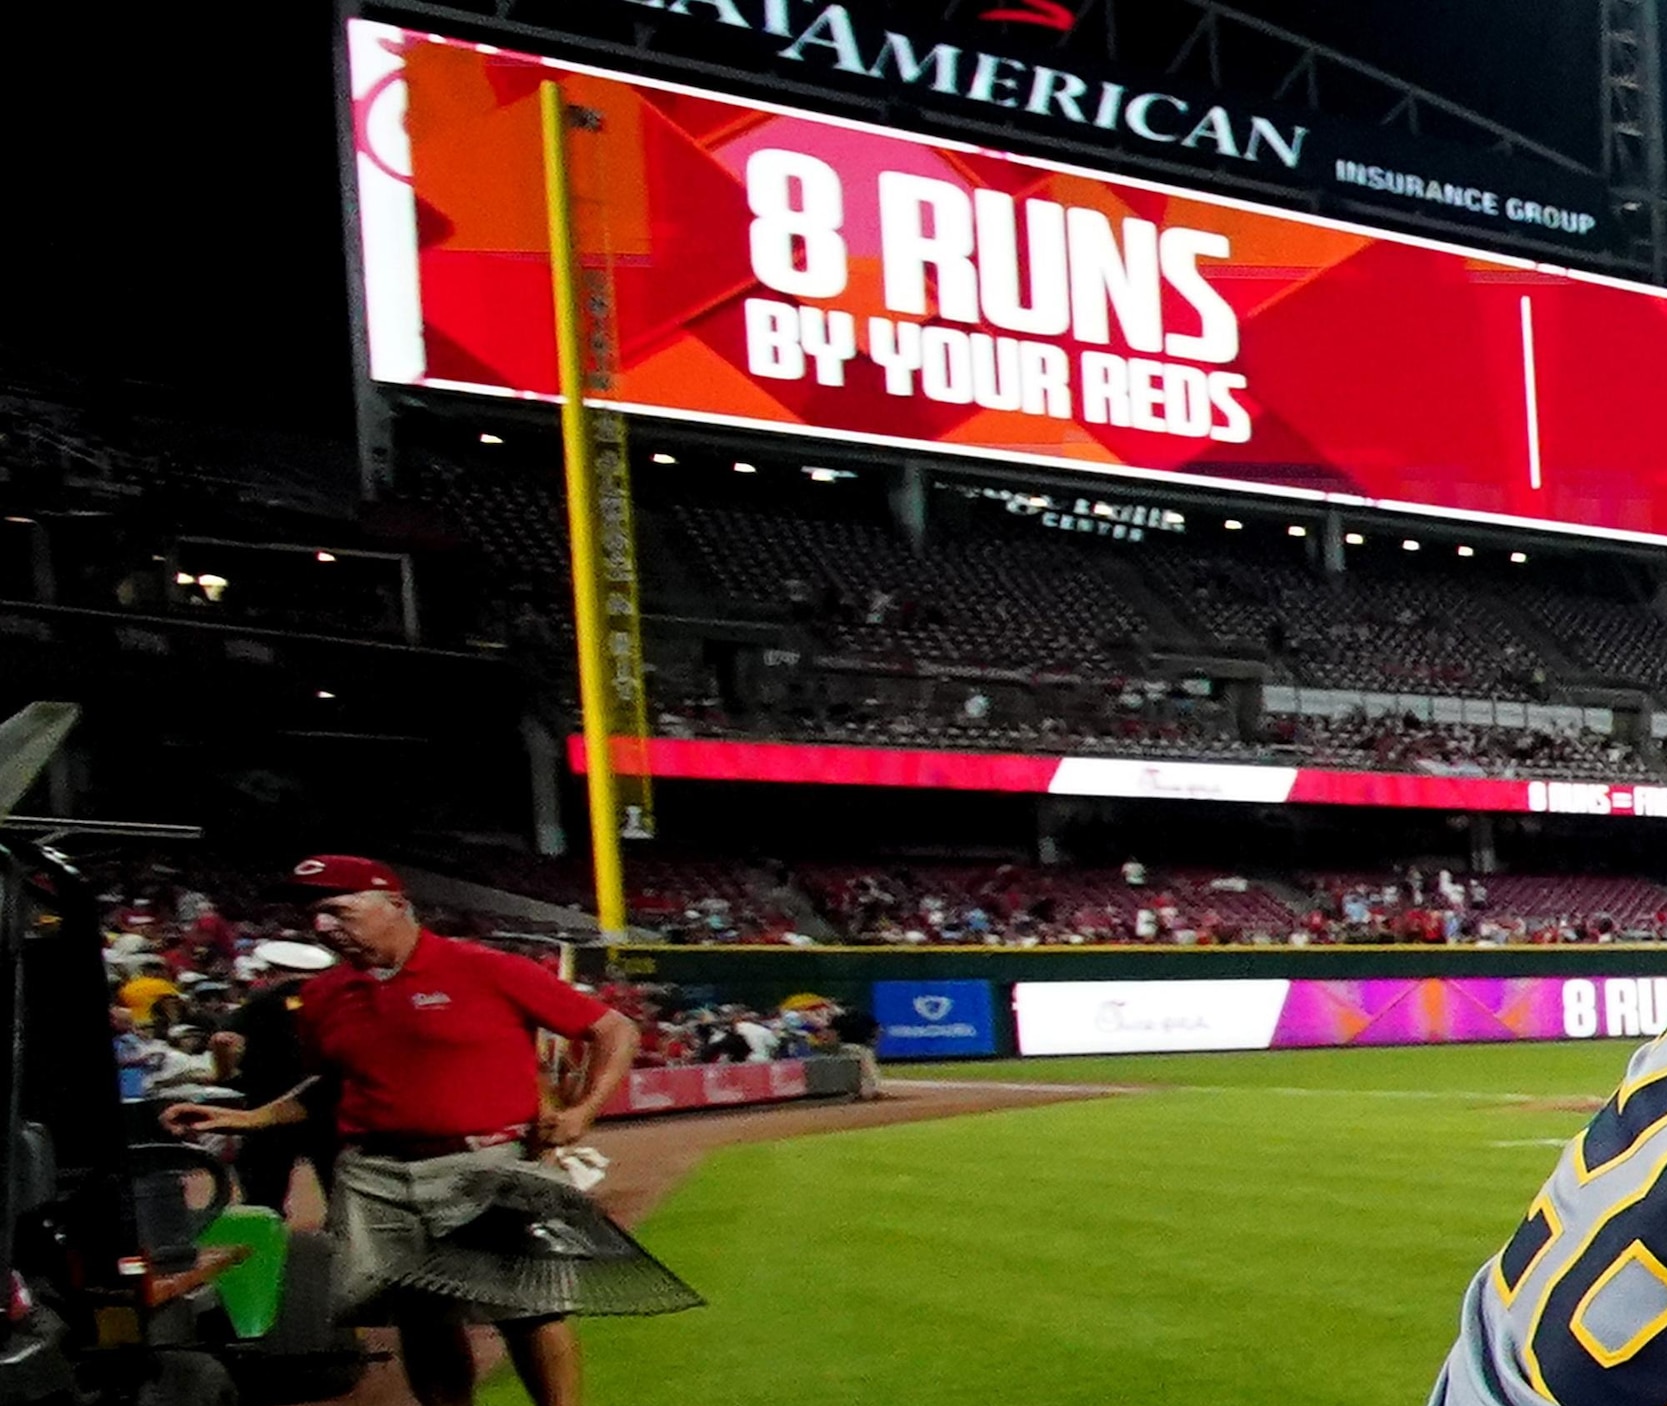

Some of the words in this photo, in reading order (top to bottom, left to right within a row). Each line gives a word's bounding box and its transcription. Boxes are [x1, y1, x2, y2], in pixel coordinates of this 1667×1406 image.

[777, 4, 1308, 168] AMERICAN
[747, 149, 846, 298] 8
[879, 171, 1240, 364] RUNS
[1336, 159, 1499, 215] INSURANCE
[1505, 197, 1596, 234] GROUP
[744, 298, 856, 387] BY
[868, 318, 1071, 420] YOUR
[1081, 352, 1251, 443] REDS
[1562, 978, 1597, 1037] 8
